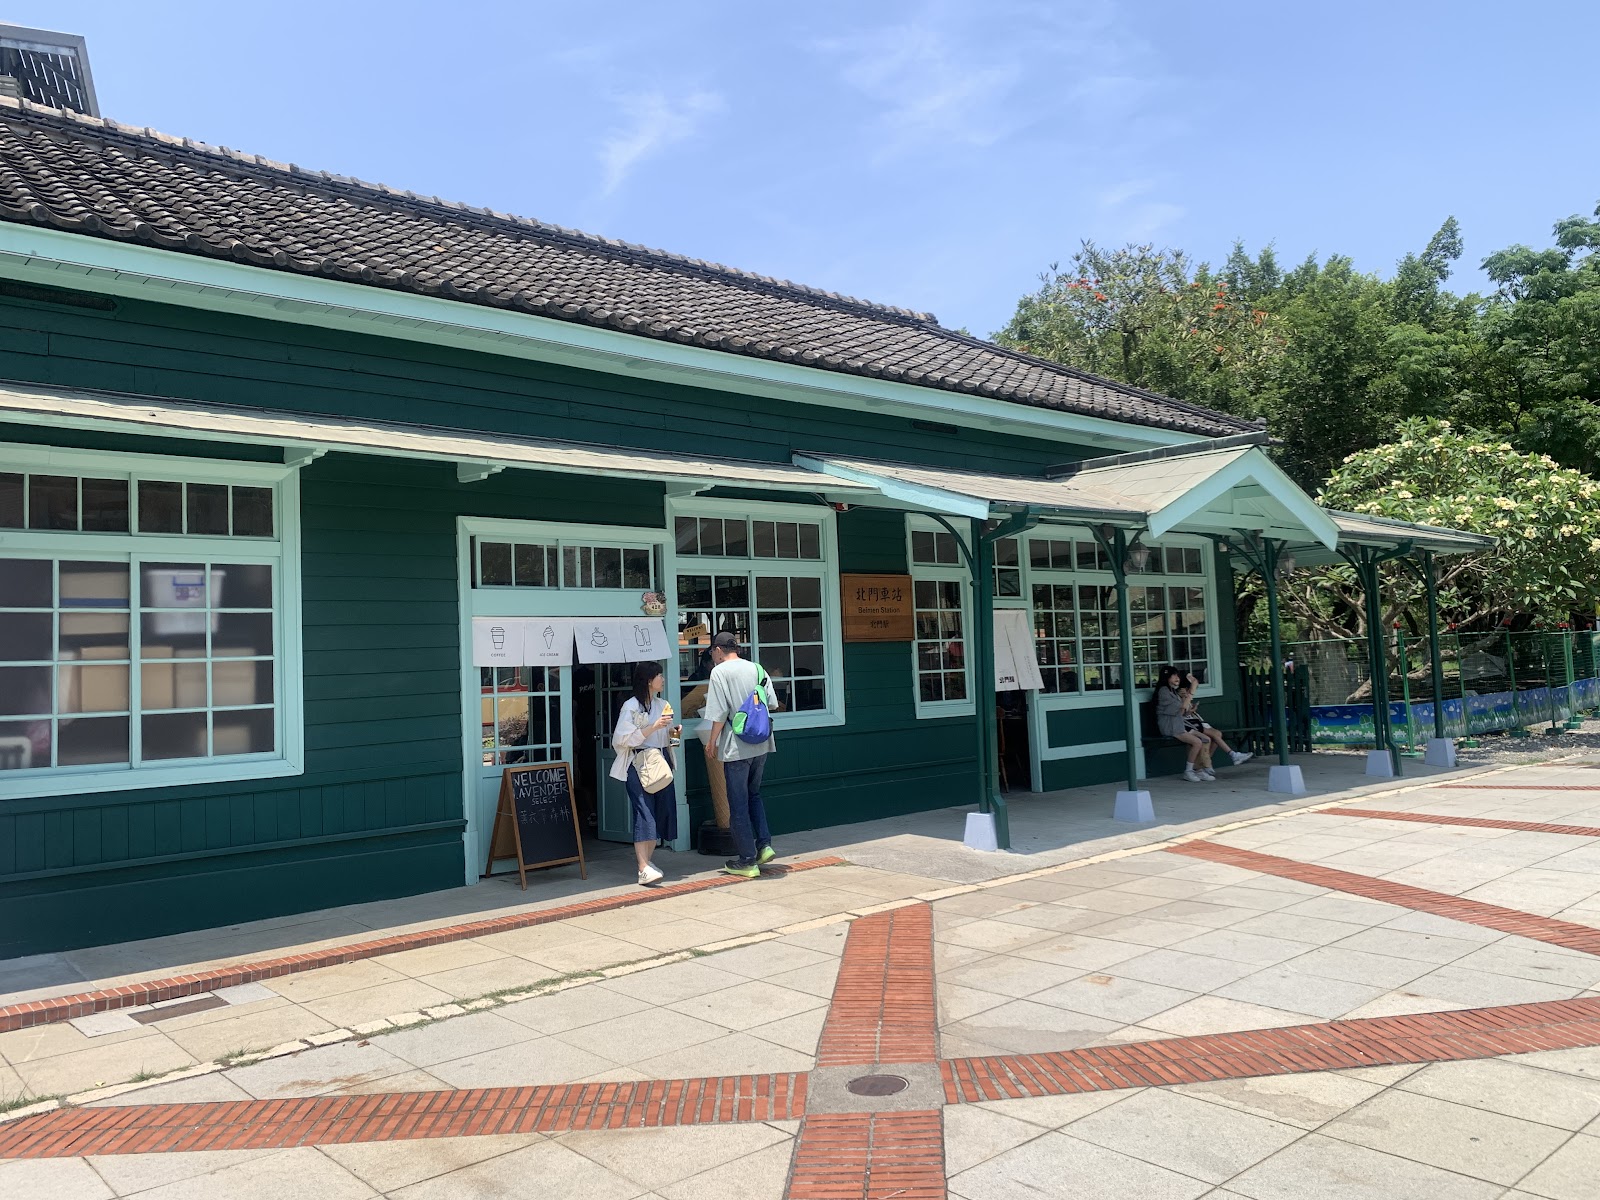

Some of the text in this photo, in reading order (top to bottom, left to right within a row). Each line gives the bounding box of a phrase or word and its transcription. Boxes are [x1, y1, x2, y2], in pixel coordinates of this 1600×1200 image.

[856, 587, 902, 602] 北門車站
[880, 606, 900, 614] Station
[514, 768, 567, 787] WELCOME
[531, 795, 558, 806] SELECT
